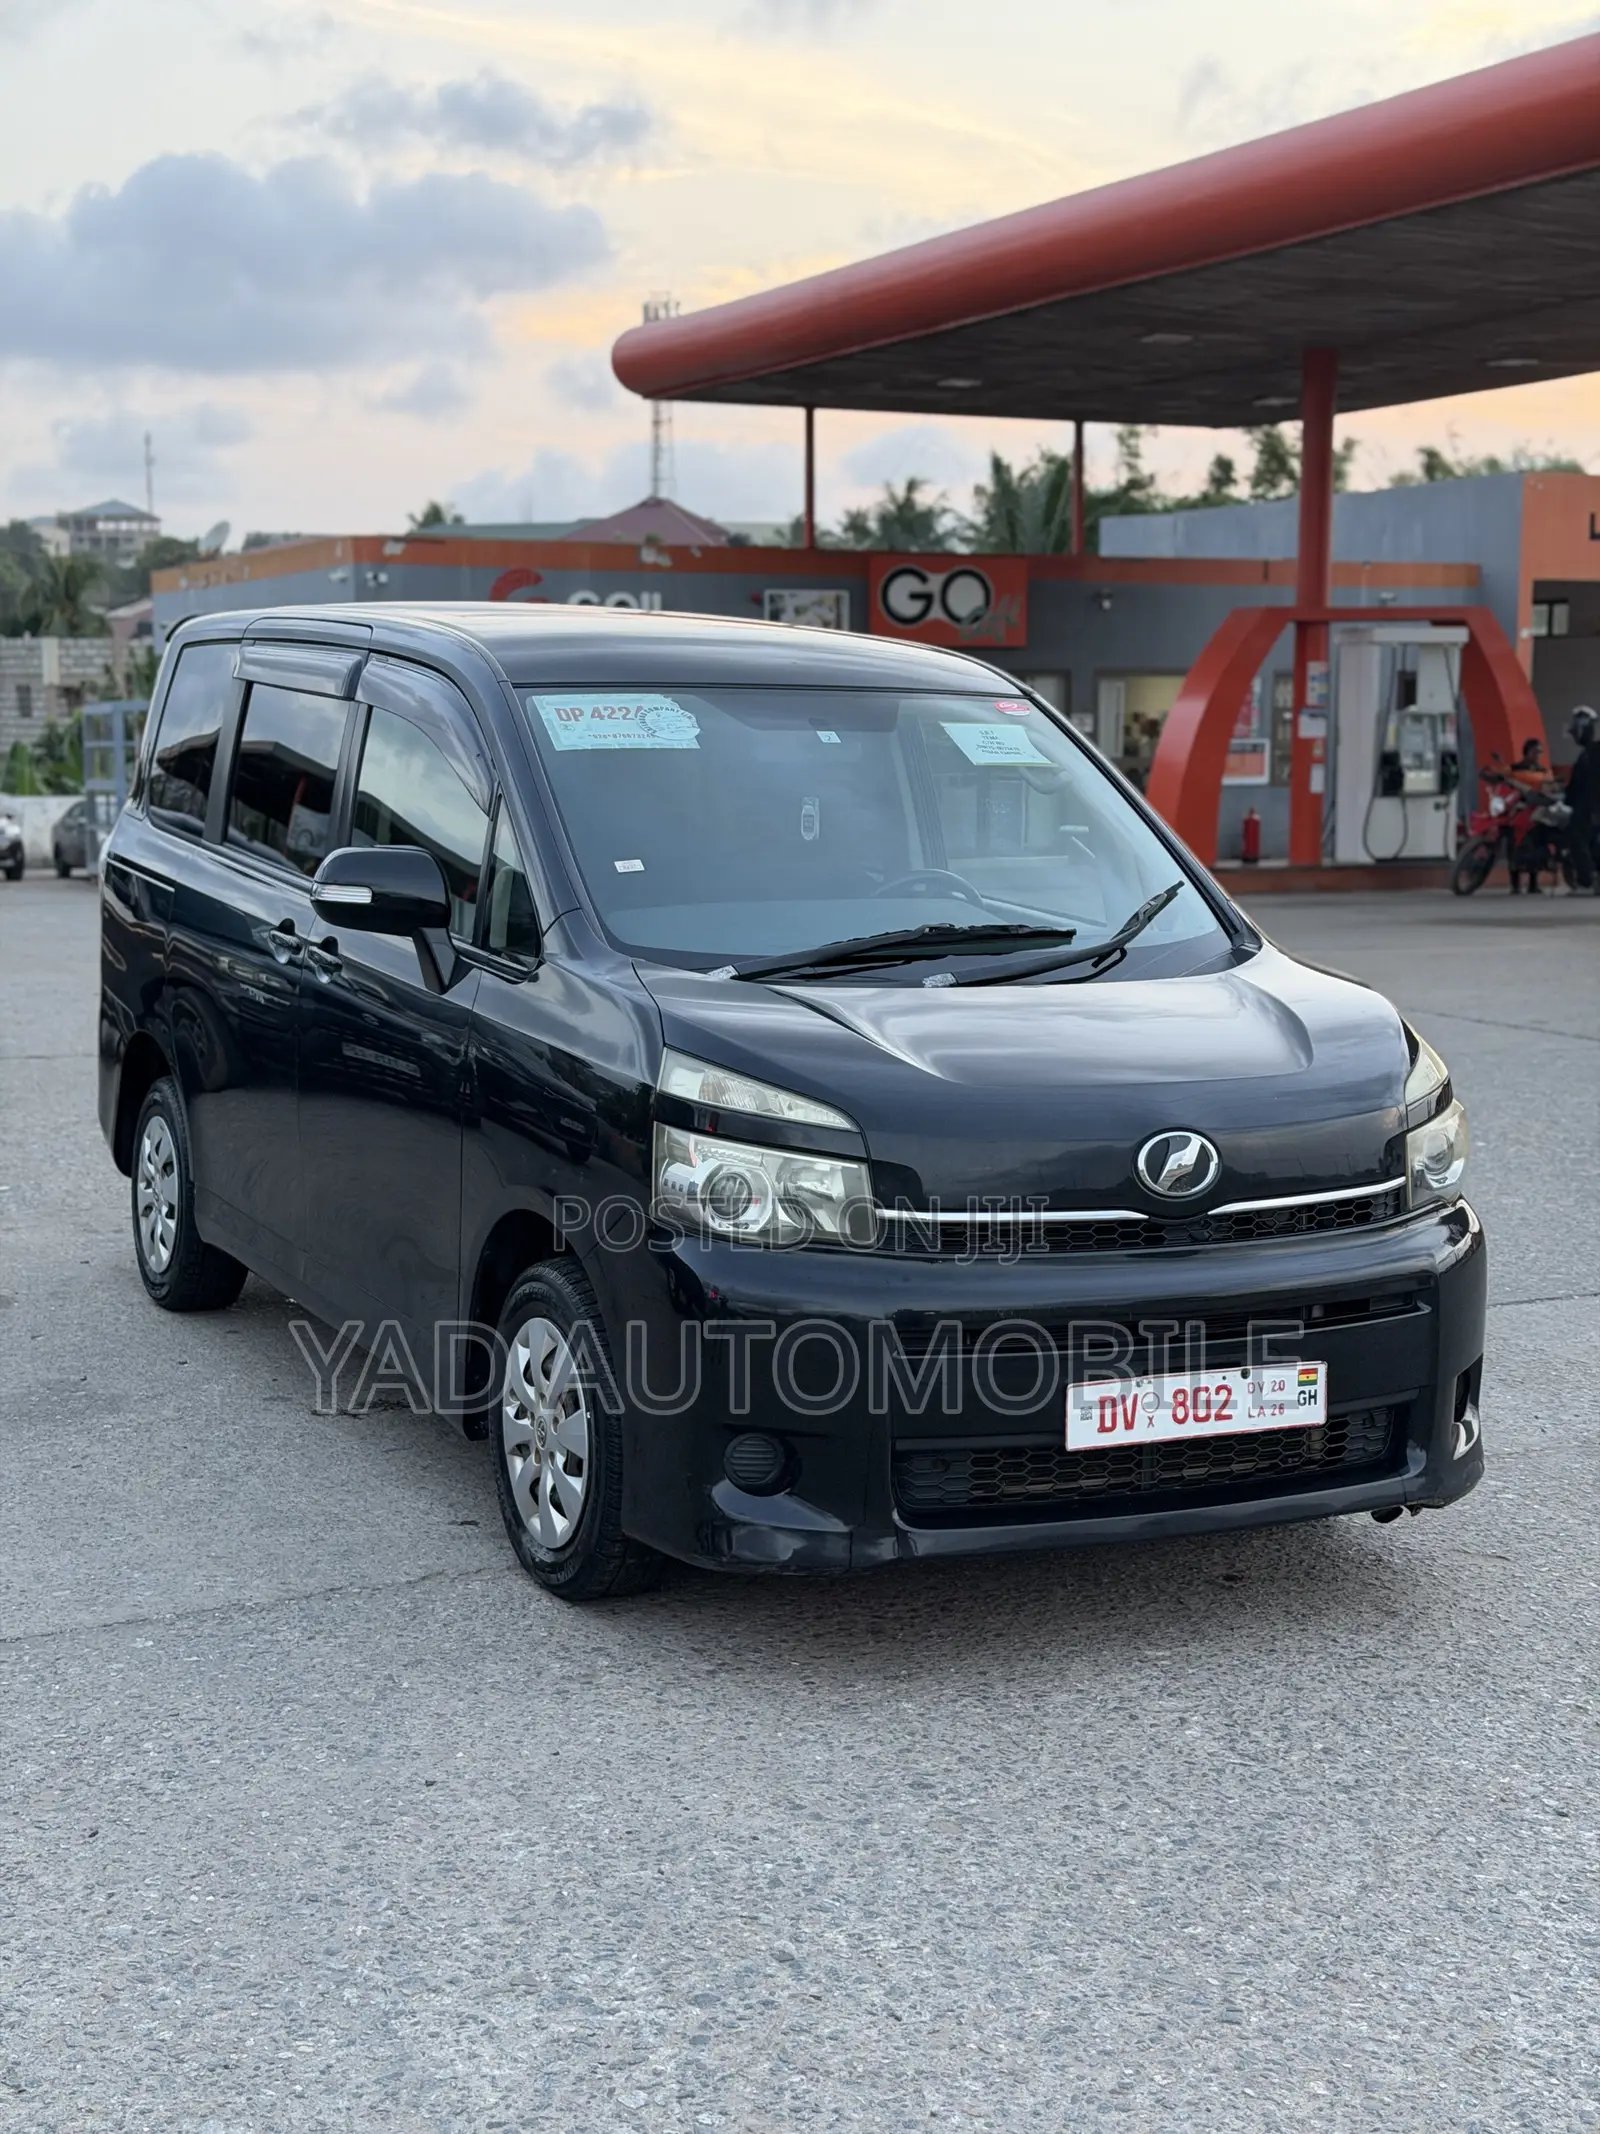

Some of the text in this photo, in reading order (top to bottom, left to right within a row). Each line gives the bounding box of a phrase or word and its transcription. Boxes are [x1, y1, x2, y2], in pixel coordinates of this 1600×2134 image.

[881, 566, 992, 626] GO
[554, 707, 585, 722] DP
[1097, 1384, 1233, 1434] DV 802
[1297, 1389, 1318, 1407] GH
